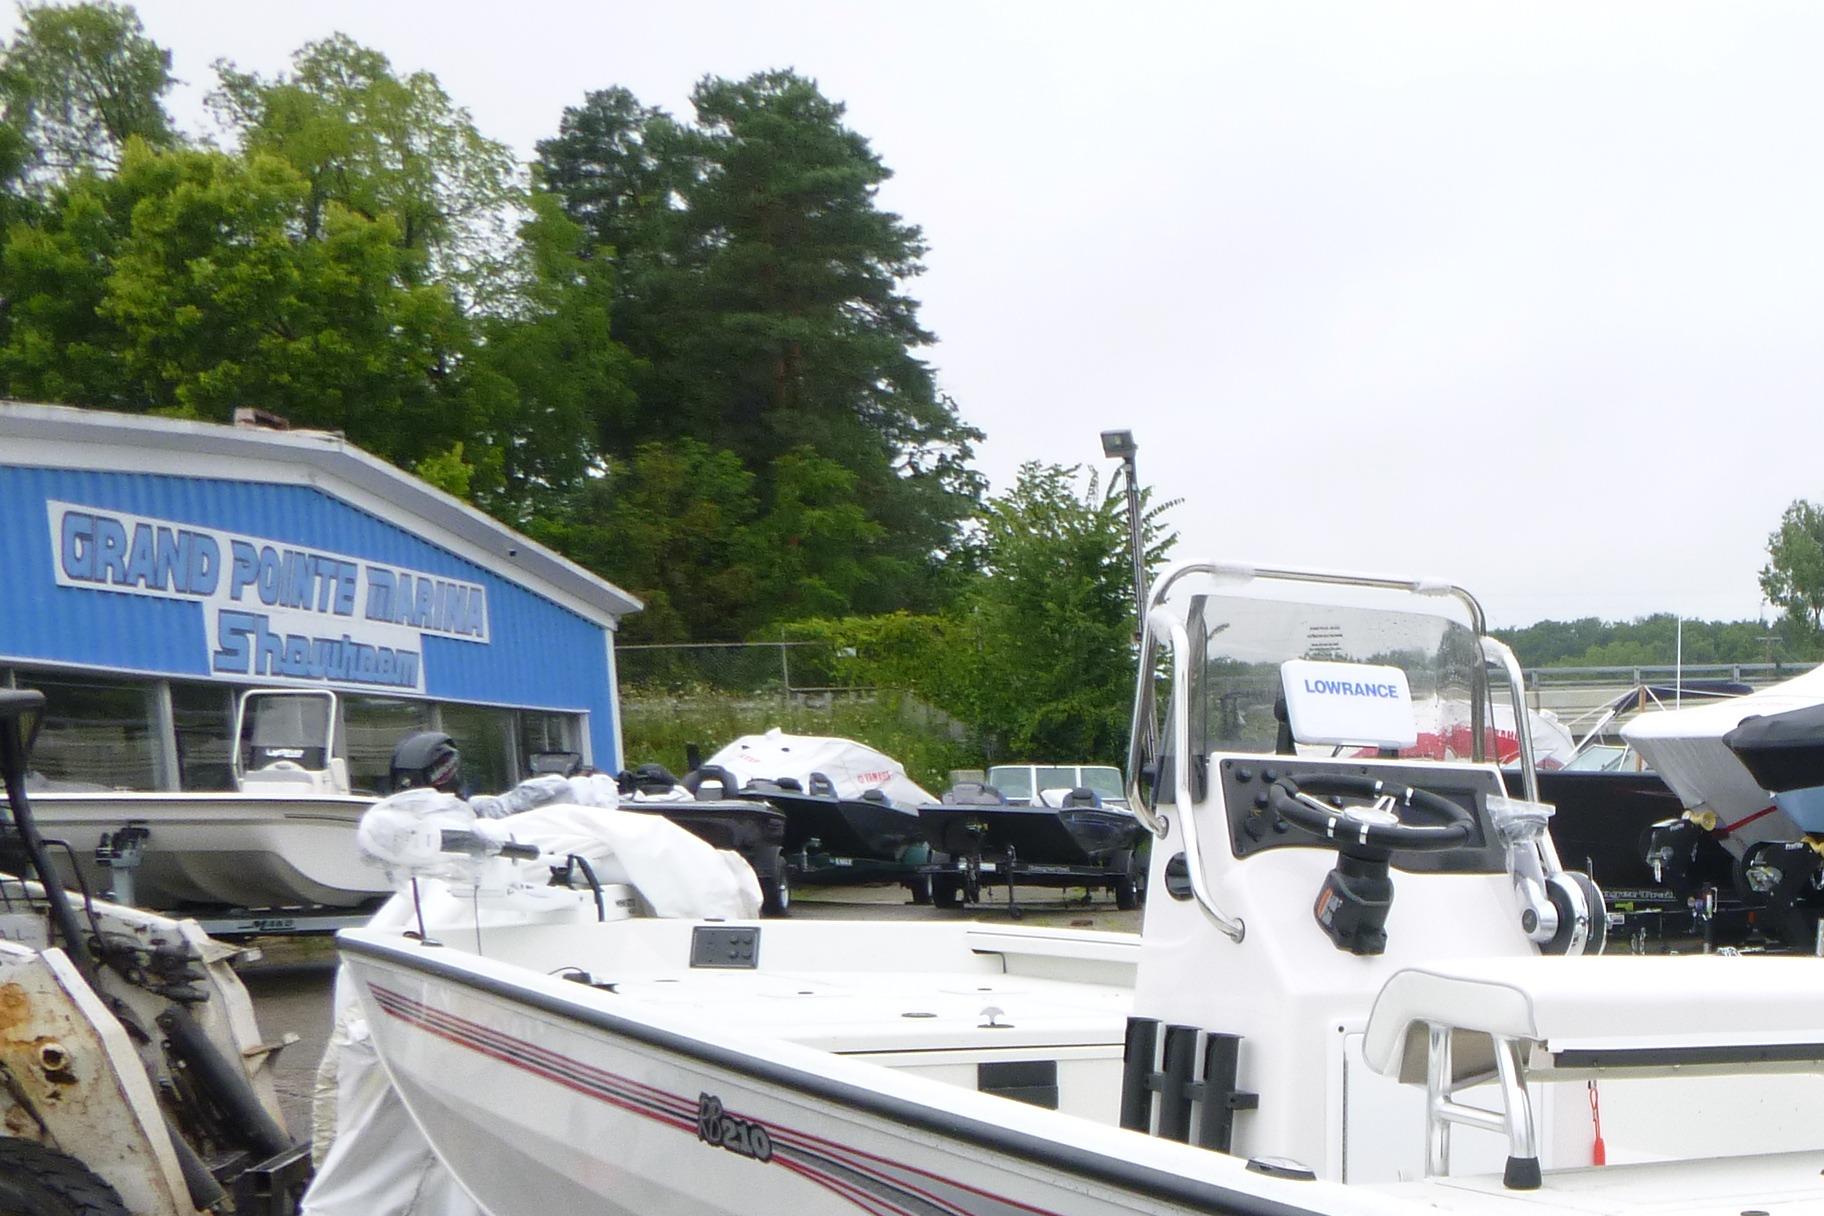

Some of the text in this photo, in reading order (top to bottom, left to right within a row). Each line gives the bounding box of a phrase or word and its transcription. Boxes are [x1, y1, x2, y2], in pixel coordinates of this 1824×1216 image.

[61, 509, 486, 639] GRAND POINTE MARINA
[1303, 678, 1400, 699] LOWRANCE
